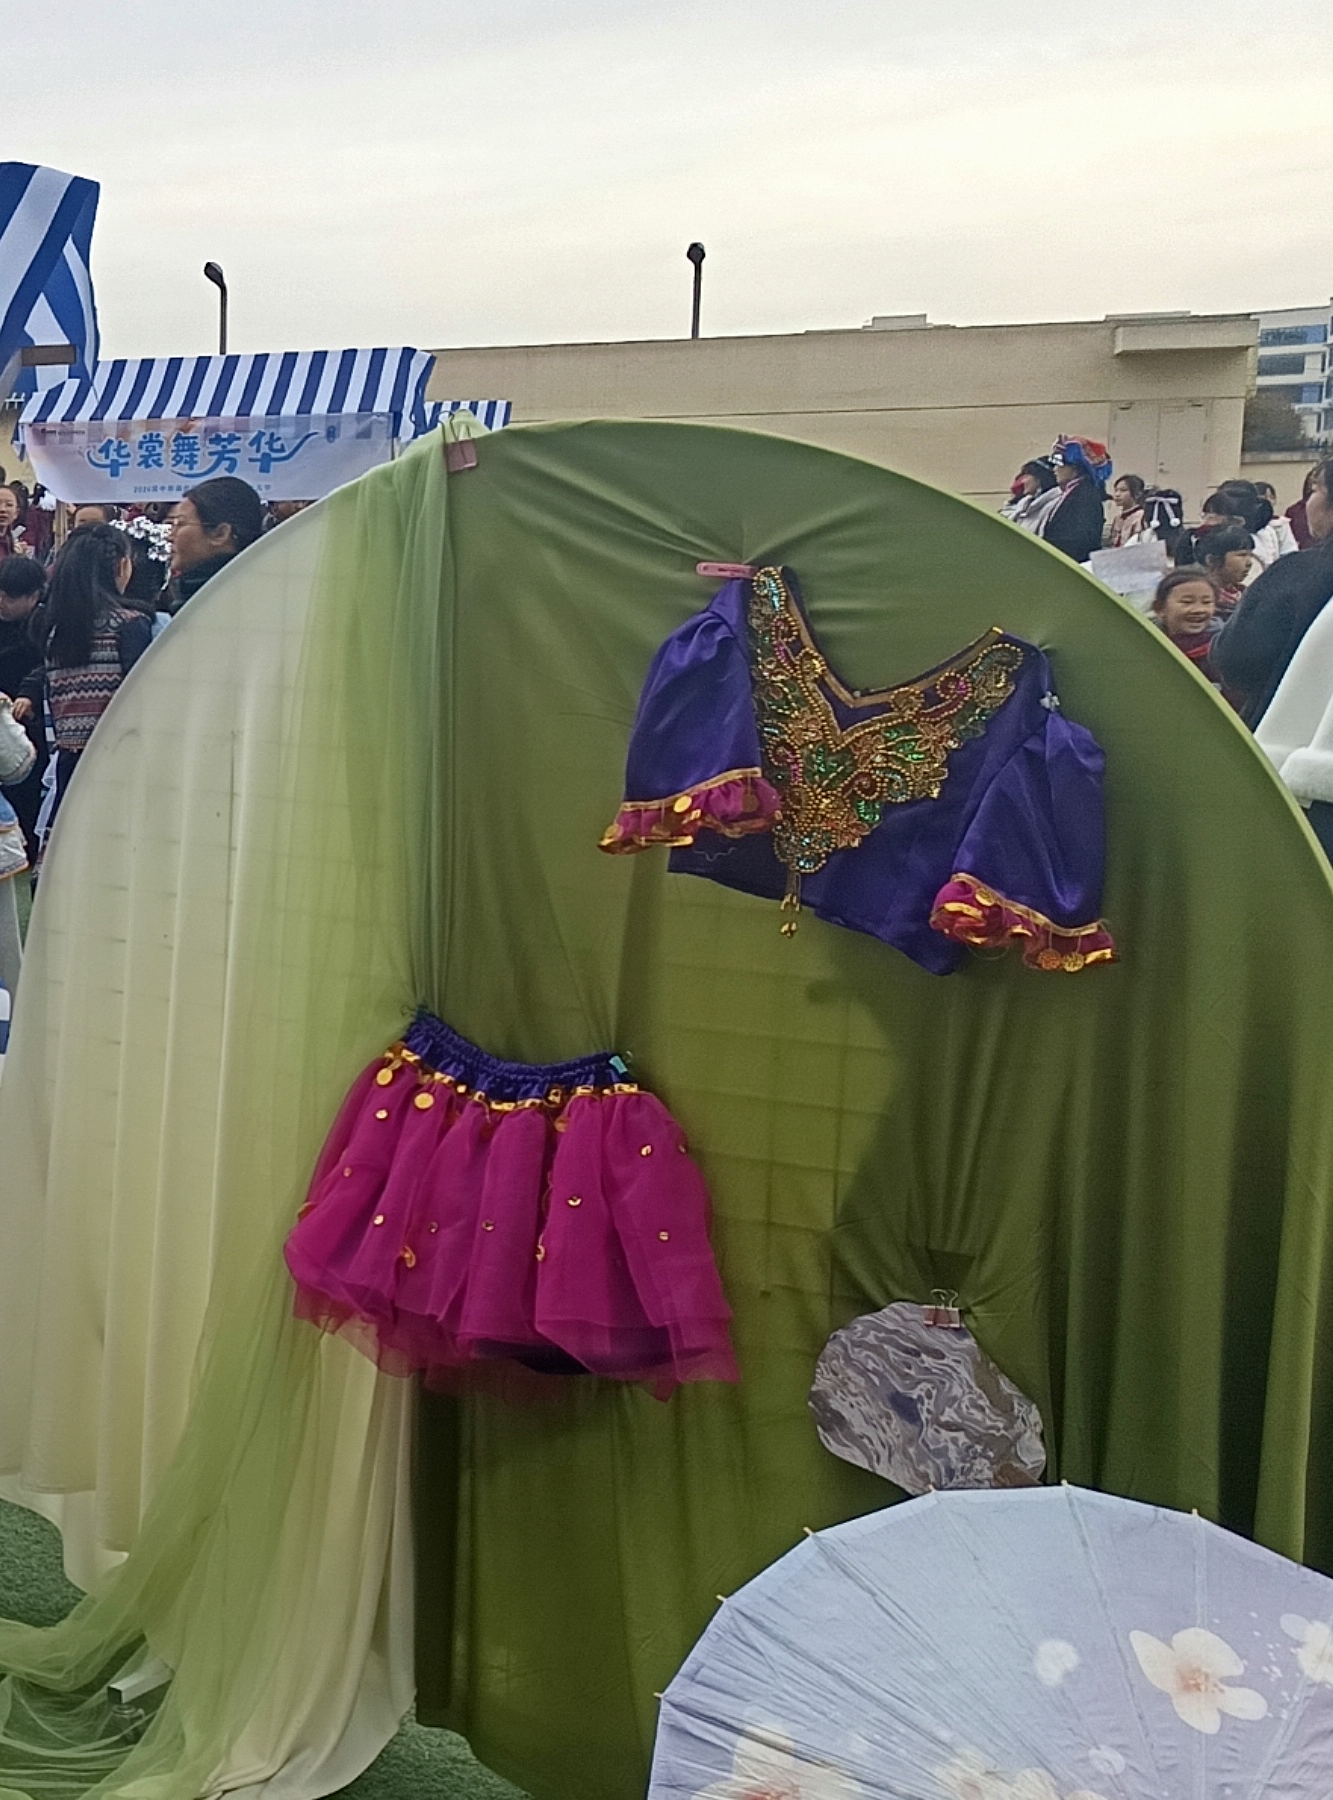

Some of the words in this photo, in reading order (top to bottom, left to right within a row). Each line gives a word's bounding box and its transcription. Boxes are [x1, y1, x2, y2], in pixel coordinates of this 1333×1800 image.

[87, 429, 321, 479] 华裳舞芳华
